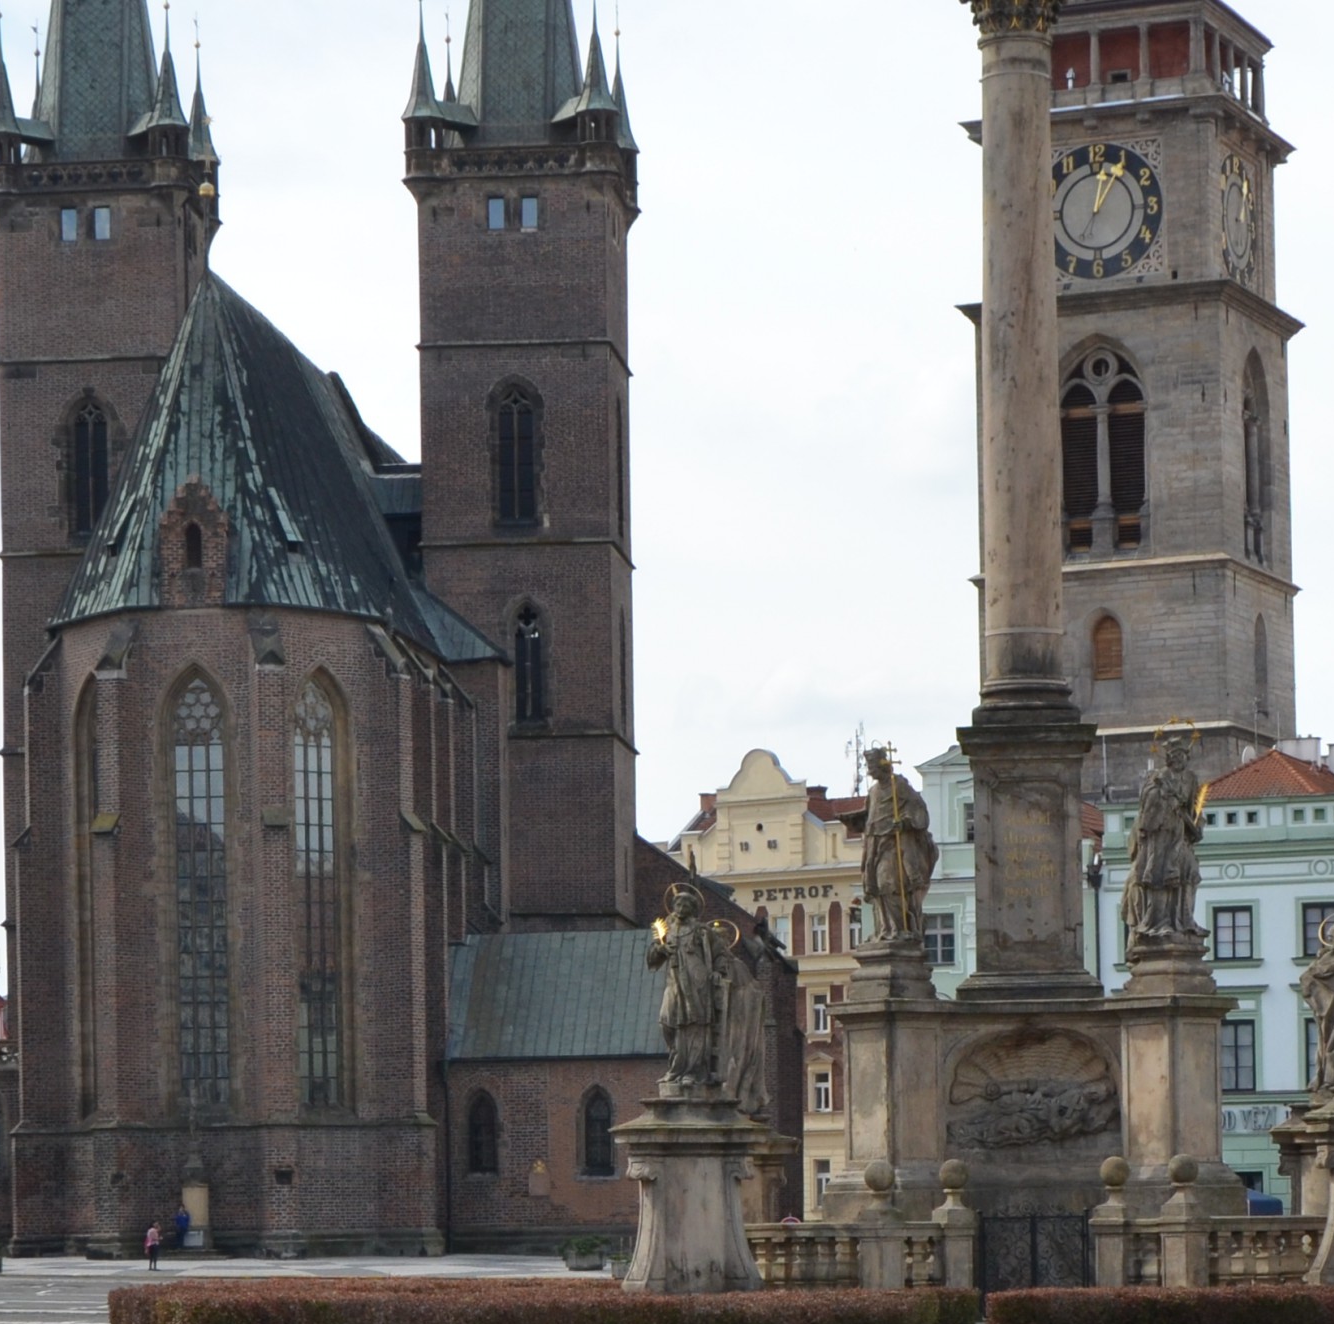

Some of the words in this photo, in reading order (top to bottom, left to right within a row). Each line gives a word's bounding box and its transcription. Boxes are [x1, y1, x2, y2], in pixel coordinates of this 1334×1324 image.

[1089, 145, 1105, 162] 12
[1062, 157, 1074, 174] 11
[1140, 169, 1150, 185] 2
[1147, 197, 1158, 214] 3
[1140, 225, 1152, 243] 4
[1067, 256, 1076, 275] 7
[1122, 251, 1132, 267] 5
[1093, 260, 1103, 277] 6
